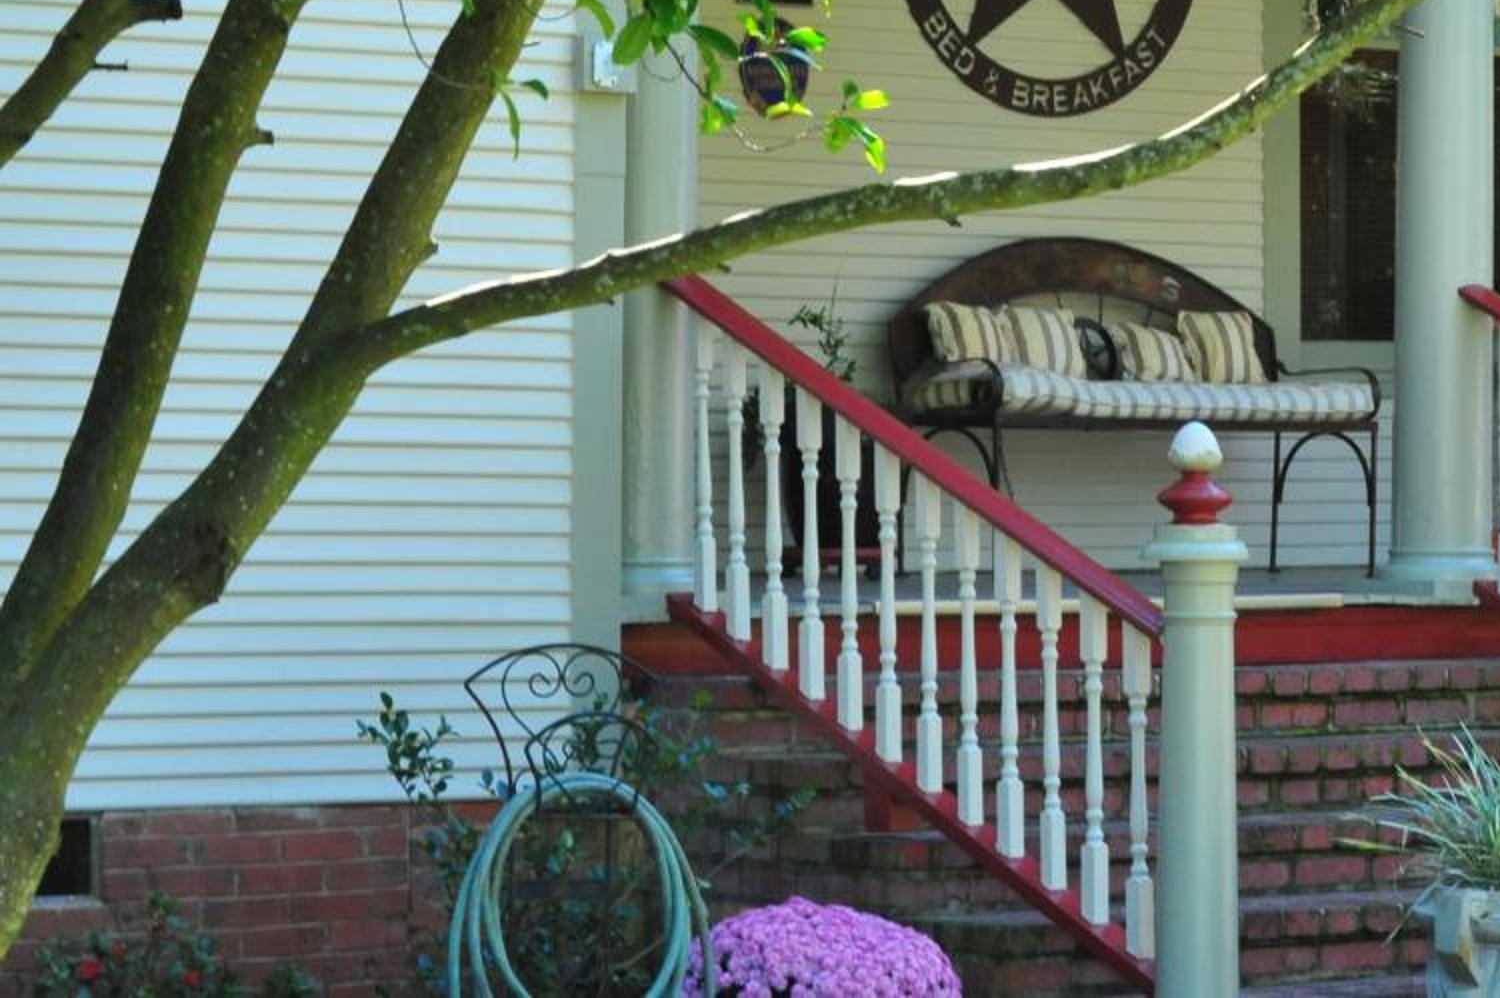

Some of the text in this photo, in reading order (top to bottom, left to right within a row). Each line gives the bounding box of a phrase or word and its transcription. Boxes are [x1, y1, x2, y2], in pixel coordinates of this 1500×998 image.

[923, 11, 1167, 113] BED & BREAKFAST
